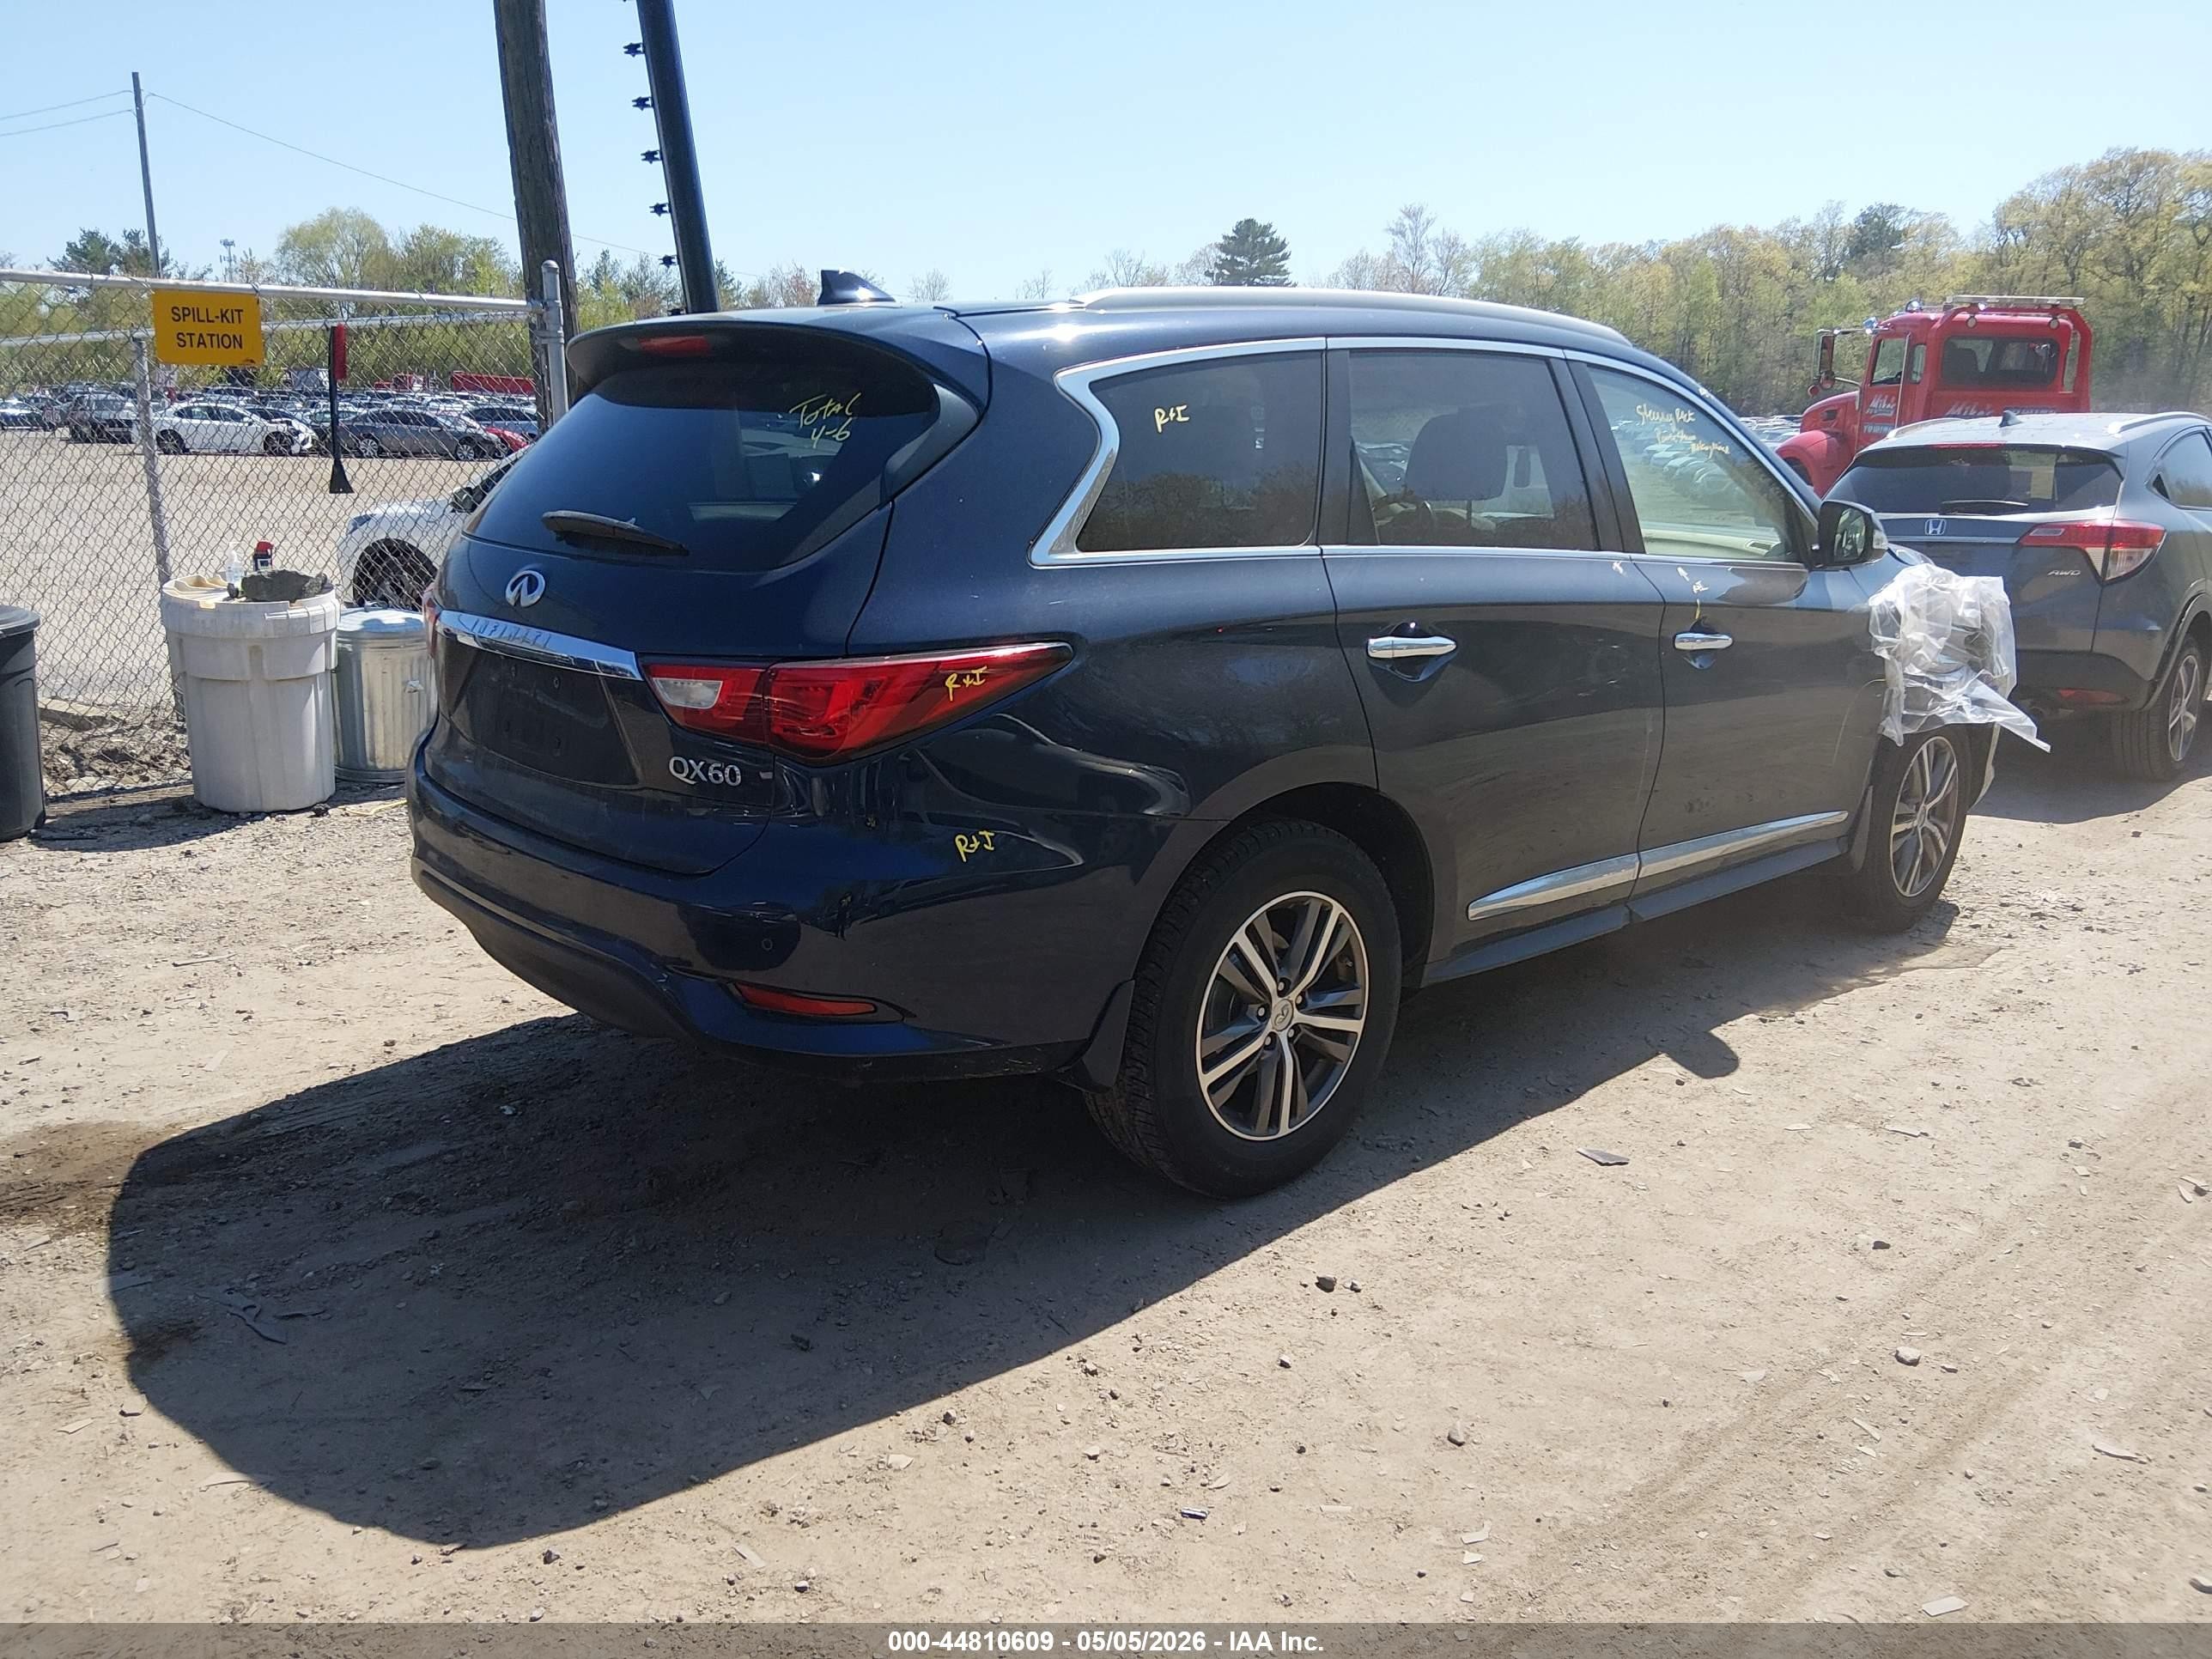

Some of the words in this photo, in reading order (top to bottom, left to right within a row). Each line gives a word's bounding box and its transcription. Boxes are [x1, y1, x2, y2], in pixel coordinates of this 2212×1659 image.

[171, 306, 244, 325] SPILL-KIT
[176, 331, 243, 349] STATION
[668, 756, 742, 787] QX60
